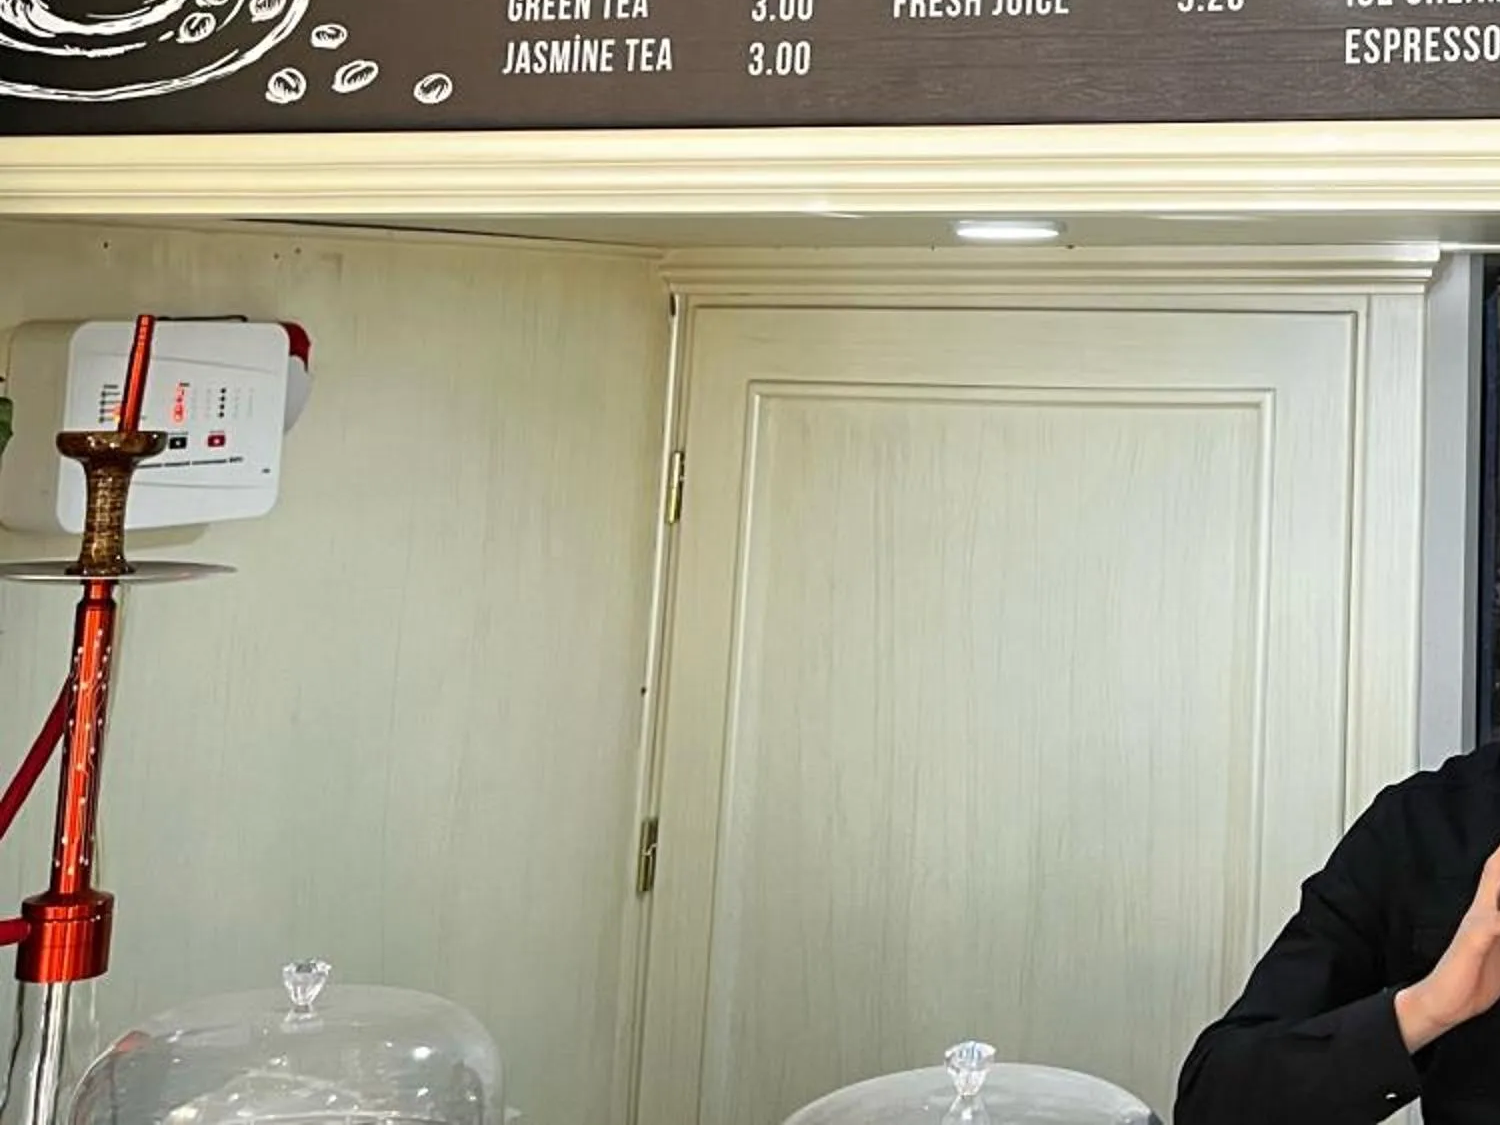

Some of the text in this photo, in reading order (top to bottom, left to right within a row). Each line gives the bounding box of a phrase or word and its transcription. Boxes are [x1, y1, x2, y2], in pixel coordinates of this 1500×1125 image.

[625, 37, 673, 72] TEA
[748, 40, 811, 76] 3.00
[1345, 24, 1500, 64] ESPRESSO
